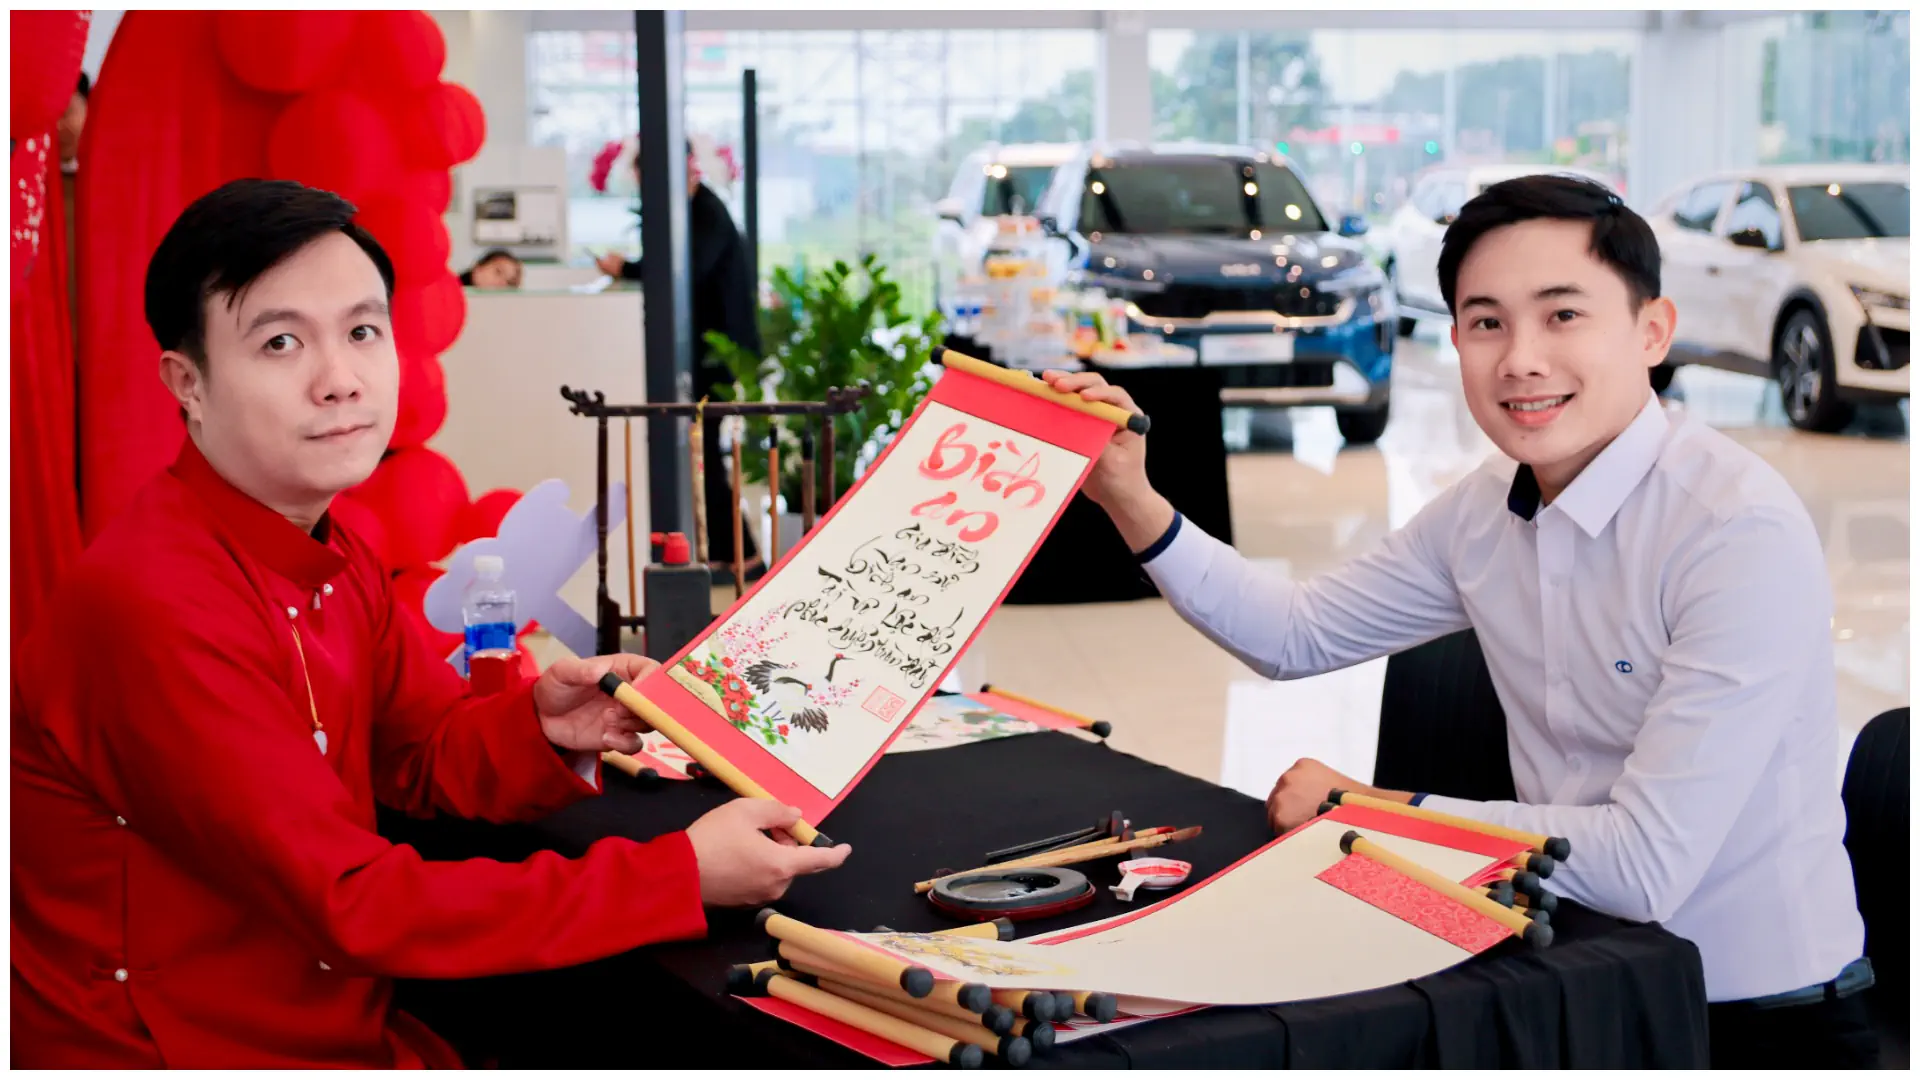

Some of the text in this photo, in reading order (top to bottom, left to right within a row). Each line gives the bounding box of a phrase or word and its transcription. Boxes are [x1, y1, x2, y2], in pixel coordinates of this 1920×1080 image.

[910, 491, 999, 543] an
[895, 522, 931, 550] Gia
[896, 588, 930, 605] an
